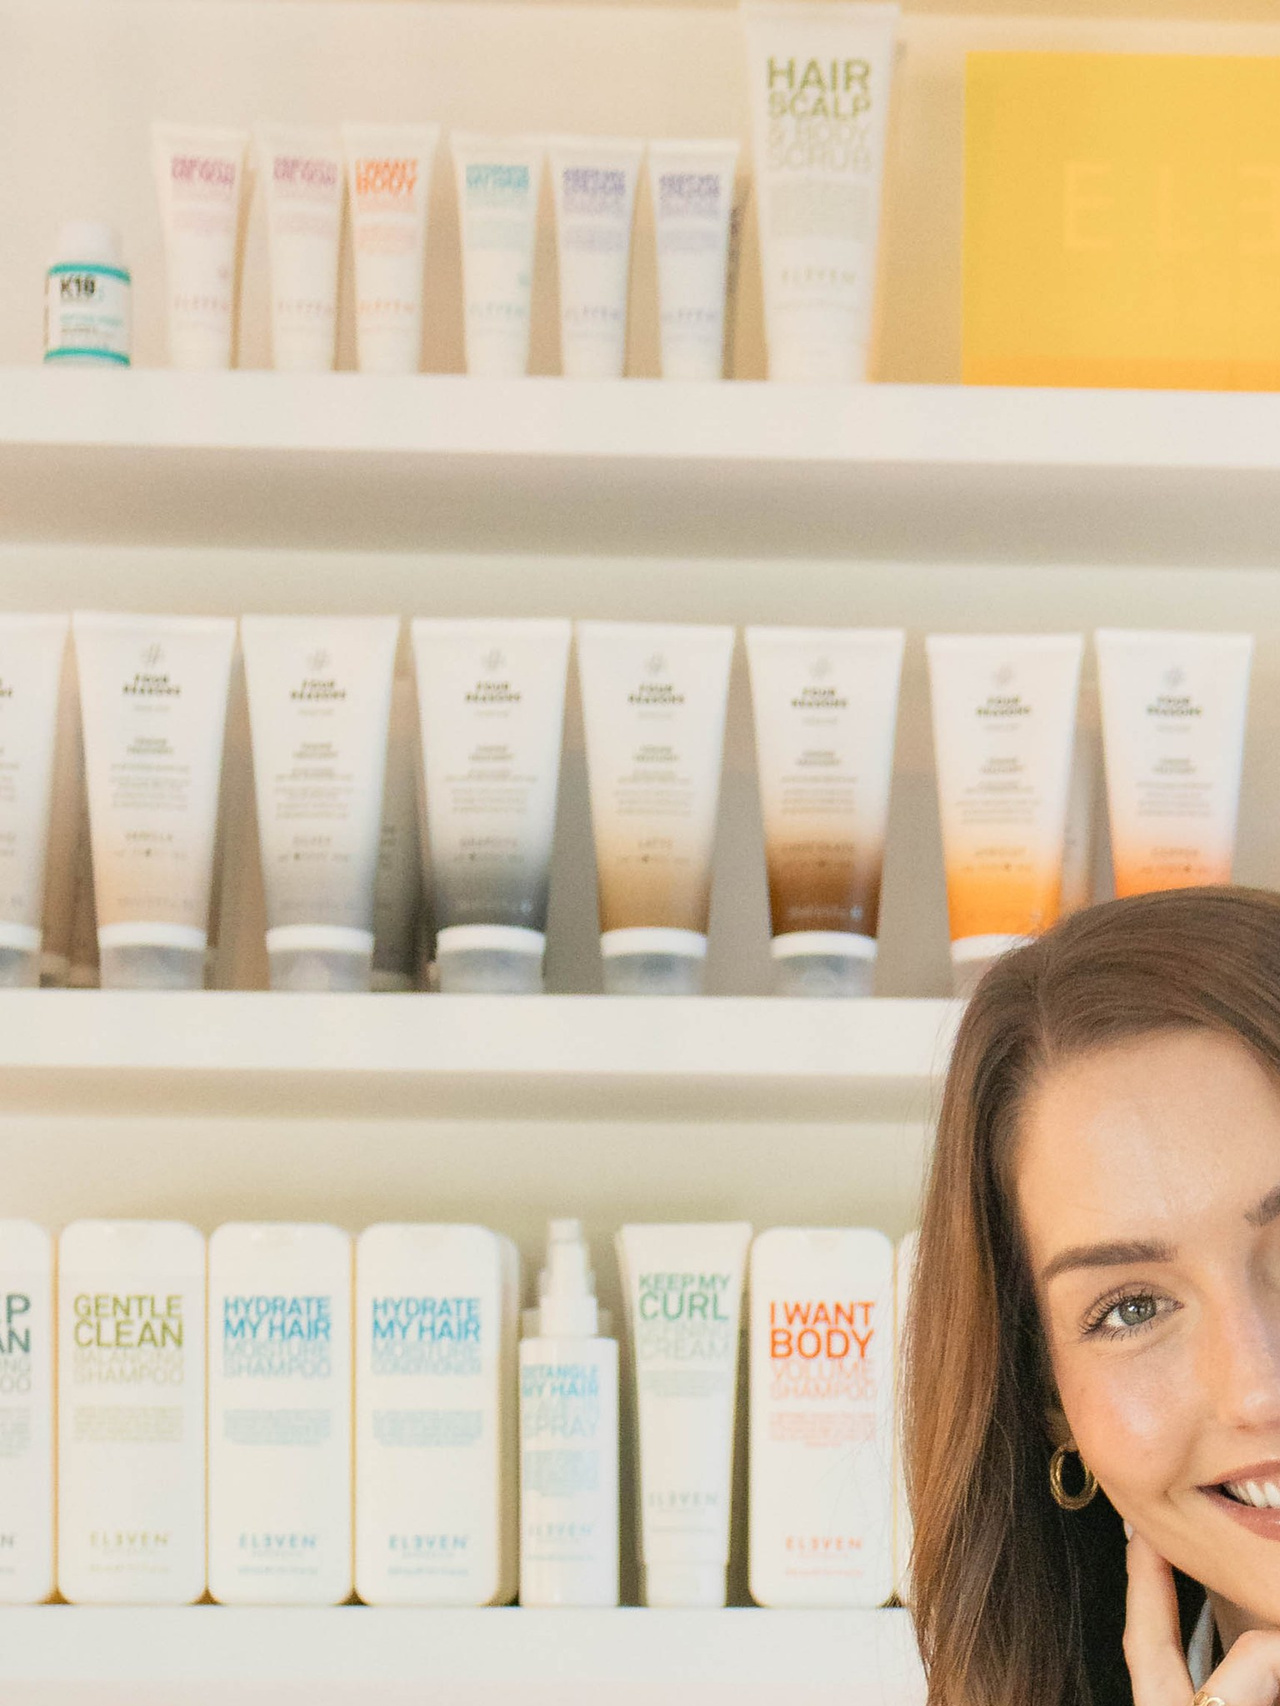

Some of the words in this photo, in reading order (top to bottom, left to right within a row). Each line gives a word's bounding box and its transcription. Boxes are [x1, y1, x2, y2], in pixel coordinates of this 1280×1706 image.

[767, 55, 872, 93] HAIR
[768, 92, 872, 120] SCALP
[638, 1273, 696, 1291] KEEP
[699, 1274, 731, 1291] MY
[73, 1294, 184, 1319] GENTLE
[223, 1295, 332, 1318] HYDRATE
[372, 1296, 481, 1319] HYDRATE
[638, 1291, 730, 1322] CURL
[769, 1301, 776, 1327] I
[783, 1301, 876, 1327] WANT
[73, 1319, 184, 1349] CLEAN
[223, 1318, 262, 1341] MY
[268, 1318, 332, 1341] HAIR
[372, 1318, 412, 1341] MY
[418, 1319, 481, 1342] HAIR
[769, 1327, 876, 1360] BODY
[73, 1366, 184, 1387] SHAMPOO
[223, 1357, 332, 1380] SHAMPOO
